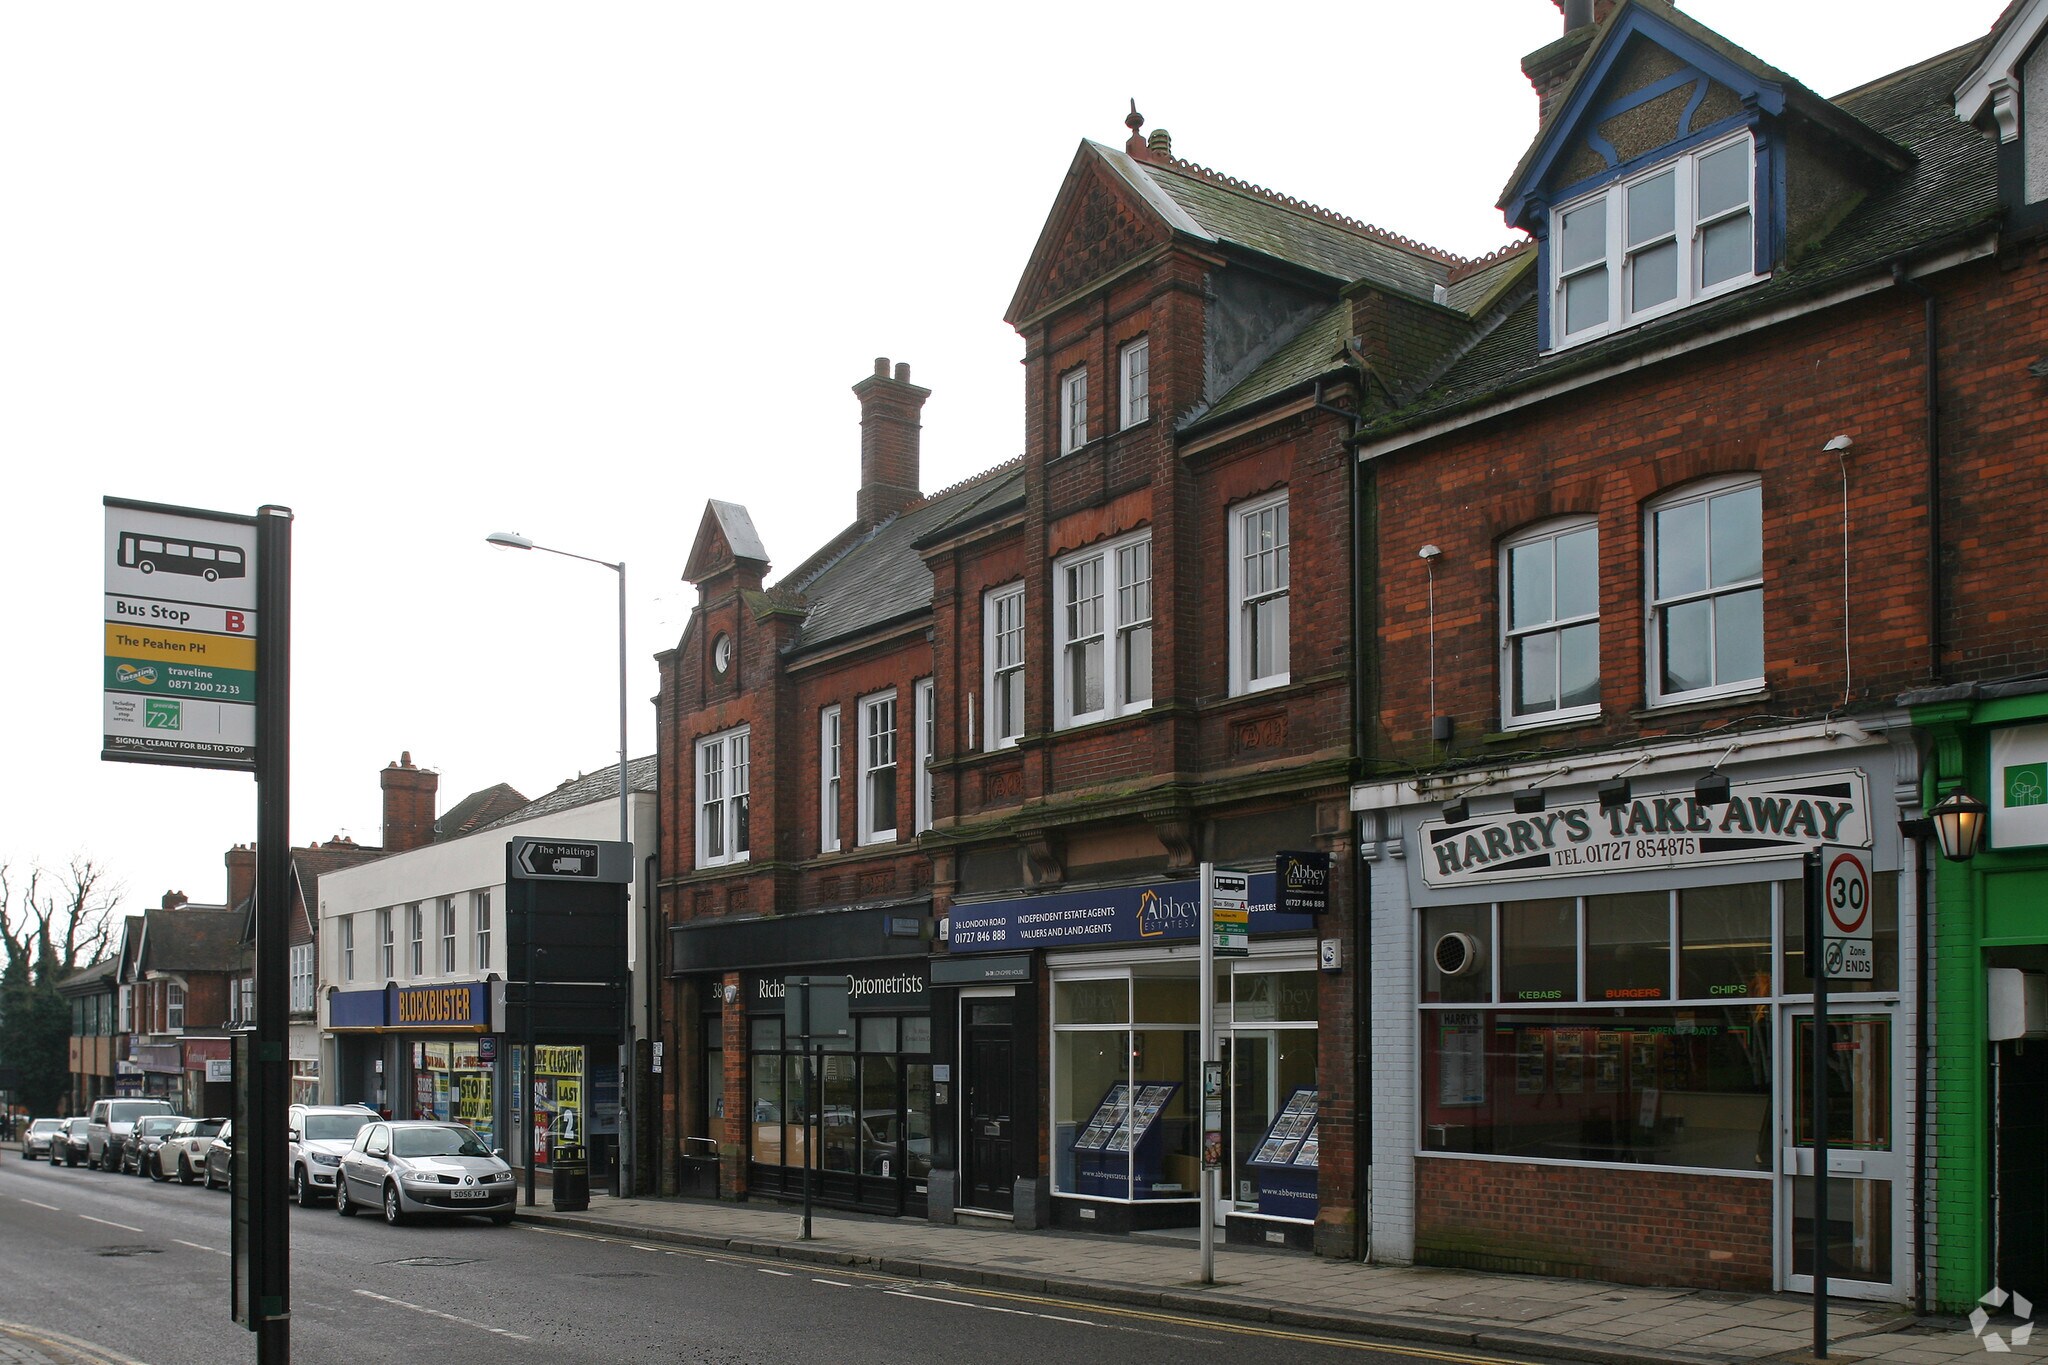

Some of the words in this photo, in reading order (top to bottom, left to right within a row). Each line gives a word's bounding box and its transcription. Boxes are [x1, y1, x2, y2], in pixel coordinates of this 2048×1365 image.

[116, 600, 146, 617] Bus
[151, 604, 190, 625] Stop
[225, 610, 246, 633] B
[116, 635, 139, 647] The
[143, 638, 186, 652] Peahen
[189, 643, 206, 654] PH
[168, 666, 213, 679] traveline
[168, 679, 192, 690] 0871
[194, 681, 214, 692] 200
[215, 684, 227, 693] 22
[229, 685, 240, 695] 33
[147, 711, 179, 729] 724
[115, 736, 145, 746] SIGNAL
[146, 739, 178, 748] CLEARLY
[180, 742, 196, 750] FOR
[197, 743, 211, 751] BUS
[1432, 808, 1593, 876] HARRY'S
[1599, 796, 1713, 837] TAKE
[1719, 796, 1853, 841] AWAY
[538, 845, 554, 854] The
[557, 846, 595, 857] Maltings
[1636, 837, 1695, 859] 854875
[1291, 864, 1327, 882] Abbey
[1832, 876, 1863, 909] 30
[1146, 896, 1201, 923] Abbey
[1240, 901, 1246, 909] A
[1246, 902, 1277, 915] yestates
[1286, 899, 1301, 908] 01727
[955, 921, 962, 929] 36
[962, 919, 989, 929] LONDON
[989, 917, 1007, 927] ROAD
[1017, 911, 1063, 924] INDEPENDENT
[1064, 909, 1087, 920] ESTATE
[1087, 907, 1115, 918] AGENTS
[1020, 928, 1047, 939] VALUERS
[1047, 927, 1063, 937] AND
[1064, 925, 1084, 935] LAND
[1084, 923, 1112, 934] AGENTS
[1144, 920, 1189, 931] ESTATES
[955, 932, 975, 944] 01727
[977, 930, 991, 942] 846
[992, 929, 1006, 941] 888
[1850, 945, 1866, 956] Zone
[1845, 960, 1871, 973] ENDS
[712, 982, 723, 999] 38
[759, 978, 785, 998] Richa
[1518, 990, 1562, 999] KEBABS
[1605, 988, 1661, 998] BURGERS
[1710, 984, 1747, 994] CHIPS
[398, 988, 471, 1022] BLOCKBUSTER
[1444, 1013, 1479, 1025] HARRY'S
[1648, 1026, 1677, 1036] OPEN
[1691, 1026, 1718, 1036] DAYS
[549, 1049, 583, 1074] CLOSING
[461, 1079, 491, 1100] STORE
[559, 1086, 578, 1102] LAST
[563, 1109, 575, 1139] 2
[474, 1190, 487, 1198] XFA
[1261, 1188, 1318, 1200] www.abbeyestates
